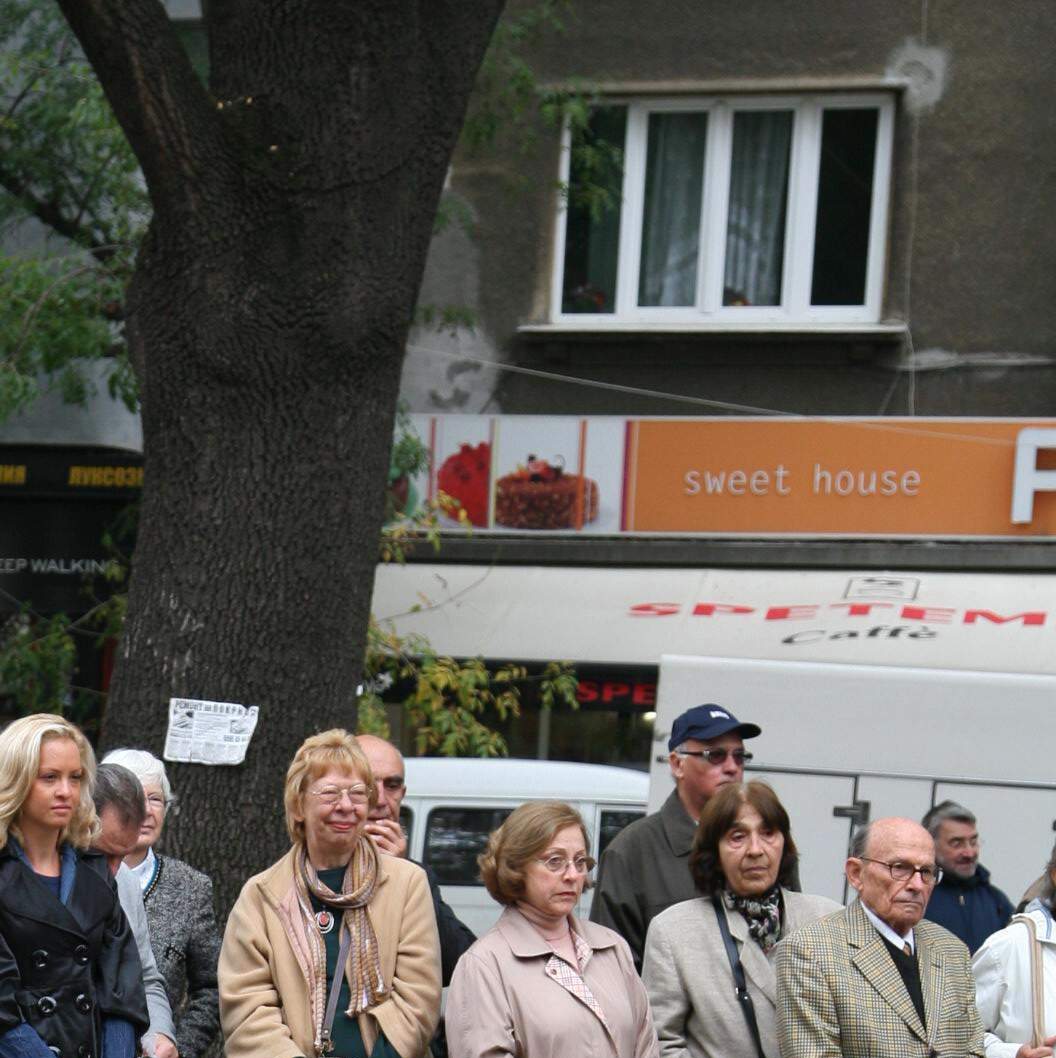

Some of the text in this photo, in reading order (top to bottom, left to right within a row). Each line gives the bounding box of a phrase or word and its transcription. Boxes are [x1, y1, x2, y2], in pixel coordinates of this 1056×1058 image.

[683, 463, 922, 496] sweet house
[780, 624, 938, 645] Caffè
